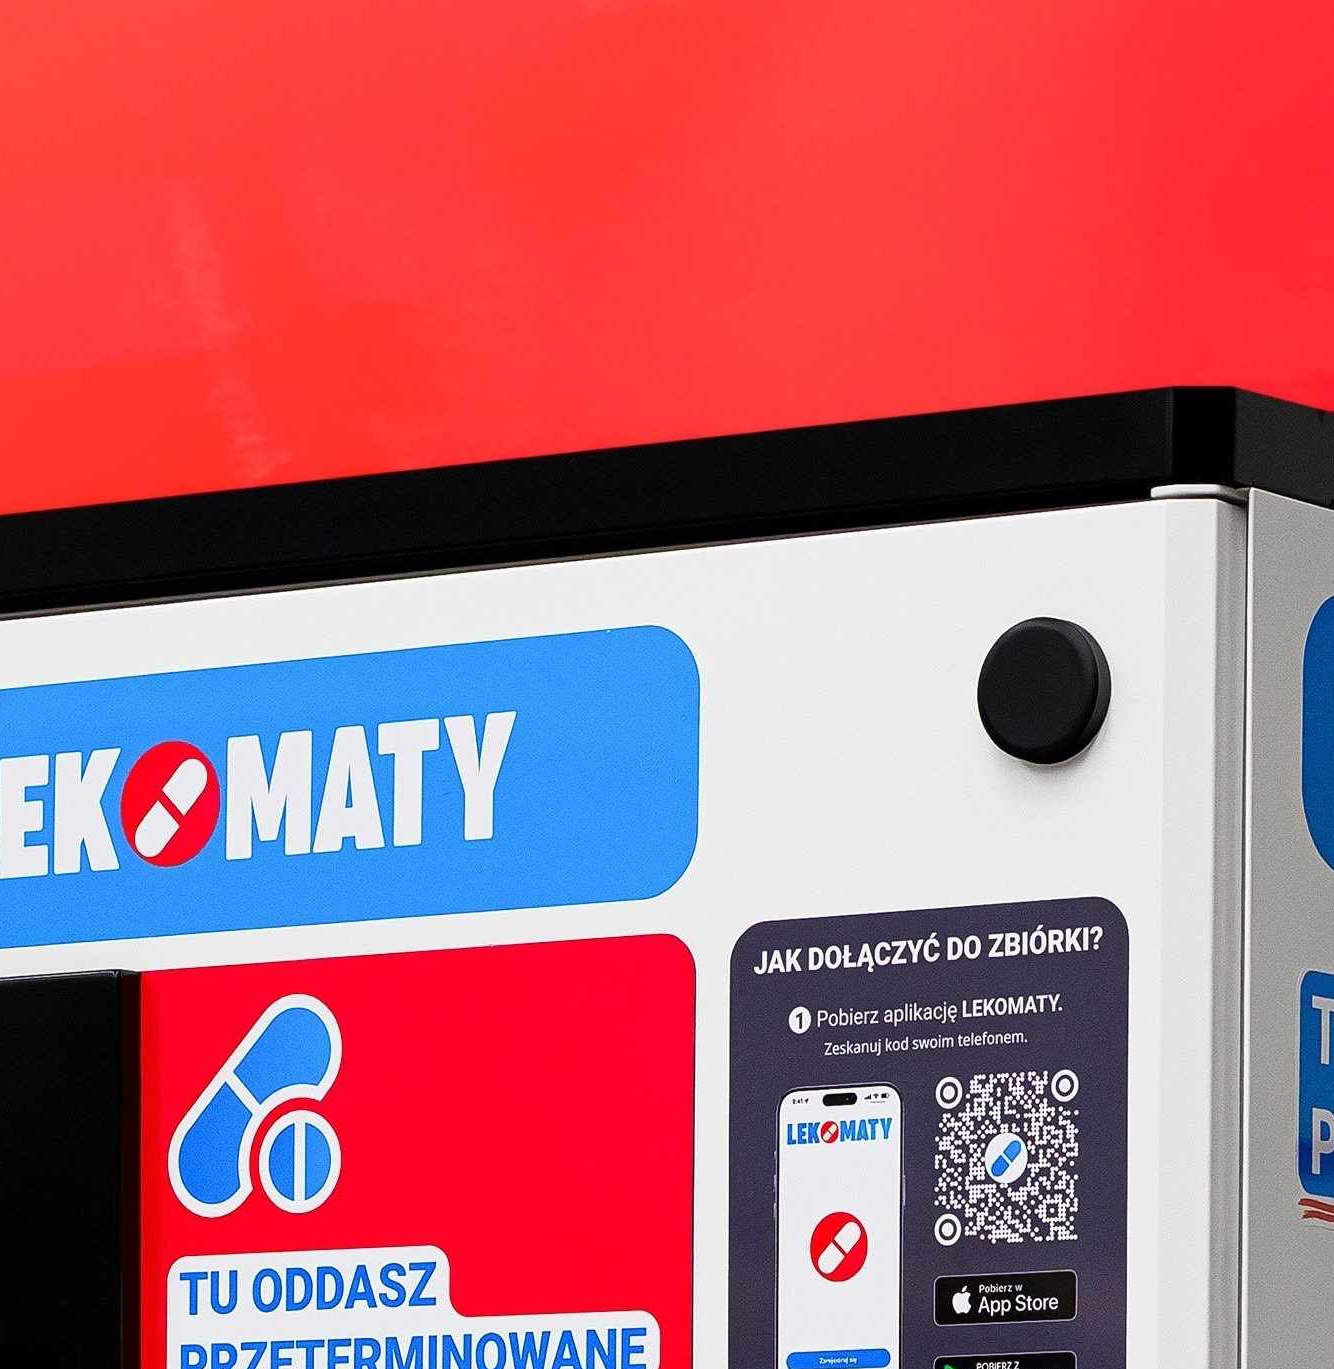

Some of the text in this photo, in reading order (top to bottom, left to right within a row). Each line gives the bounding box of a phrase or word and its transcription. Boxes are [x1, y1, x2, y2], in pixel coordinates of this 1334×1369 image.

[753, 924, 1103, 975] JAK DOŁĄCZYĆ DO ZBIÓRKI?
[817, 1007, 879, 1028] Pobierz
[883, 1001, 957, 1027] aplikację
[962, 993, 1063, 1018] LEKOMATY.
[824, 1030, 1028, 1056] Zeskanuj kod swoim telefonem.
[179, 1261, 437, 1316] TU ODDASZ
[978, 1283, 1023, 1293] Pobierz w
[977, 1294, 1059, 1316] App Store
